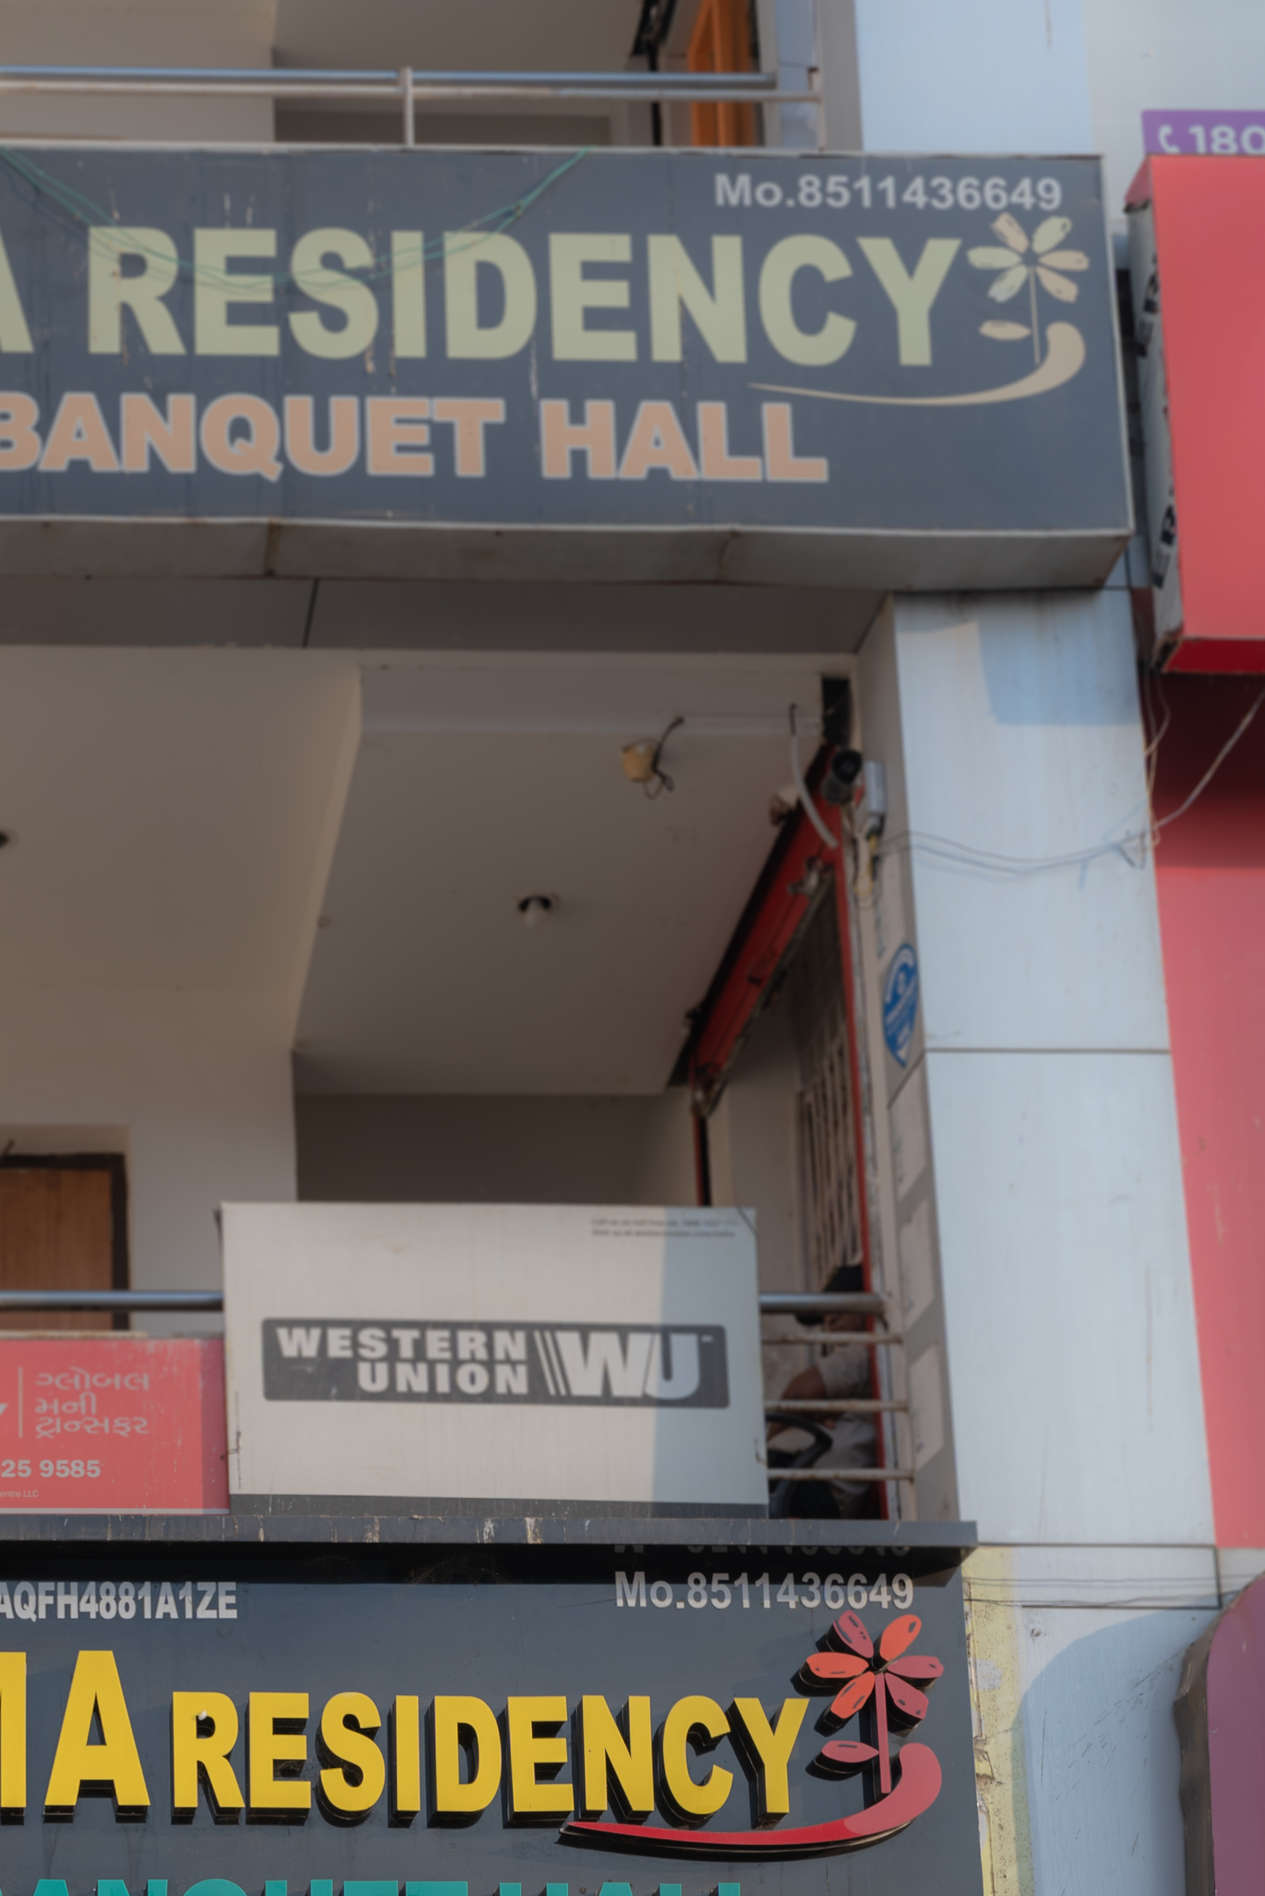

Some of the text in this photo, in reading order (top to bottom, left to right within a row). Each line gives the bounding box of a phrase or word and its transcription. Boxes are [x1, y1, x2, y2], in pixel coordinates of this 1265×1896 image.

[714, 172, 1063, 212] Mo.8511436649
[86, 226, 963, 367] RESIDENCY
[539, 400, 829, 483] HALL
[275, 1326, 527, 1361] WESTERN
[357, 1361, 528, 1395] UNION
[554, 1329, 701, 1401] WU
[33, 1391, 97, 1415] મની
[39, 1460, 101, 1479] 9585
[614, 1570, 914, 1610] Mo.8511436649
[171, 1691, 811, 1822] RESIDENCY
